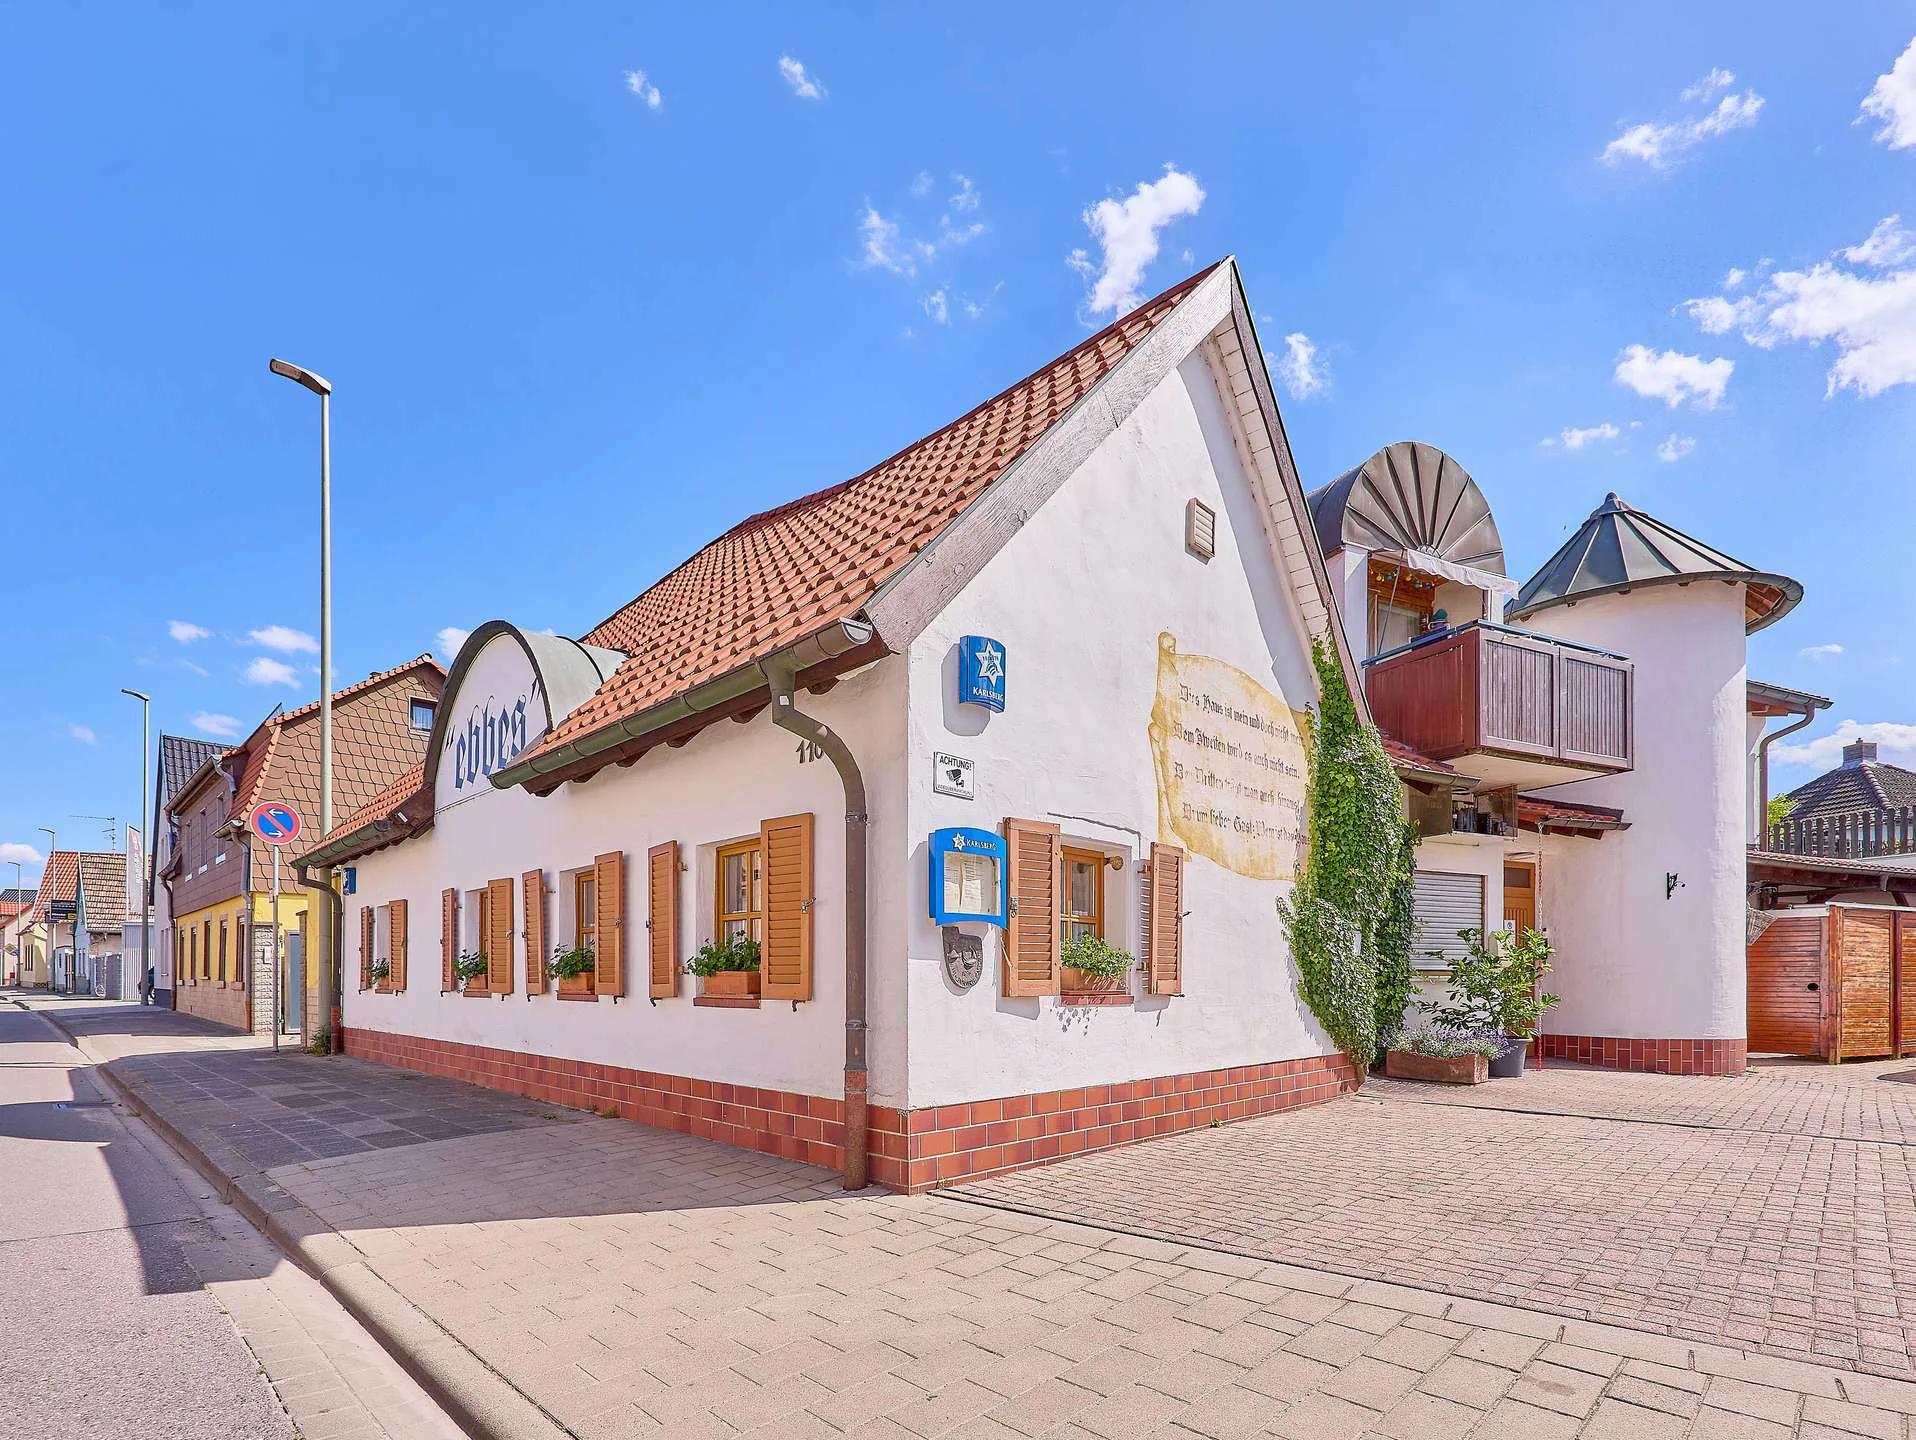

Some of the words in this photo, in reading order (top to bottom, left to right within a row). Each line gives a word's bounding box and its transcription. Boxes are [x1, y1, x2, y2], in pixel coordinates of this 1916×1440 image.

[1202, 694, 1224, 714] Haus
[1224, 702, 1233, 720] ist
[1233, 709, 1249, 726] mein
[795, 739, 824, 764] 110
[939, 755, 973, 771] ACHTUNG!
[966, 839, 996, 851] KARLSBERG
